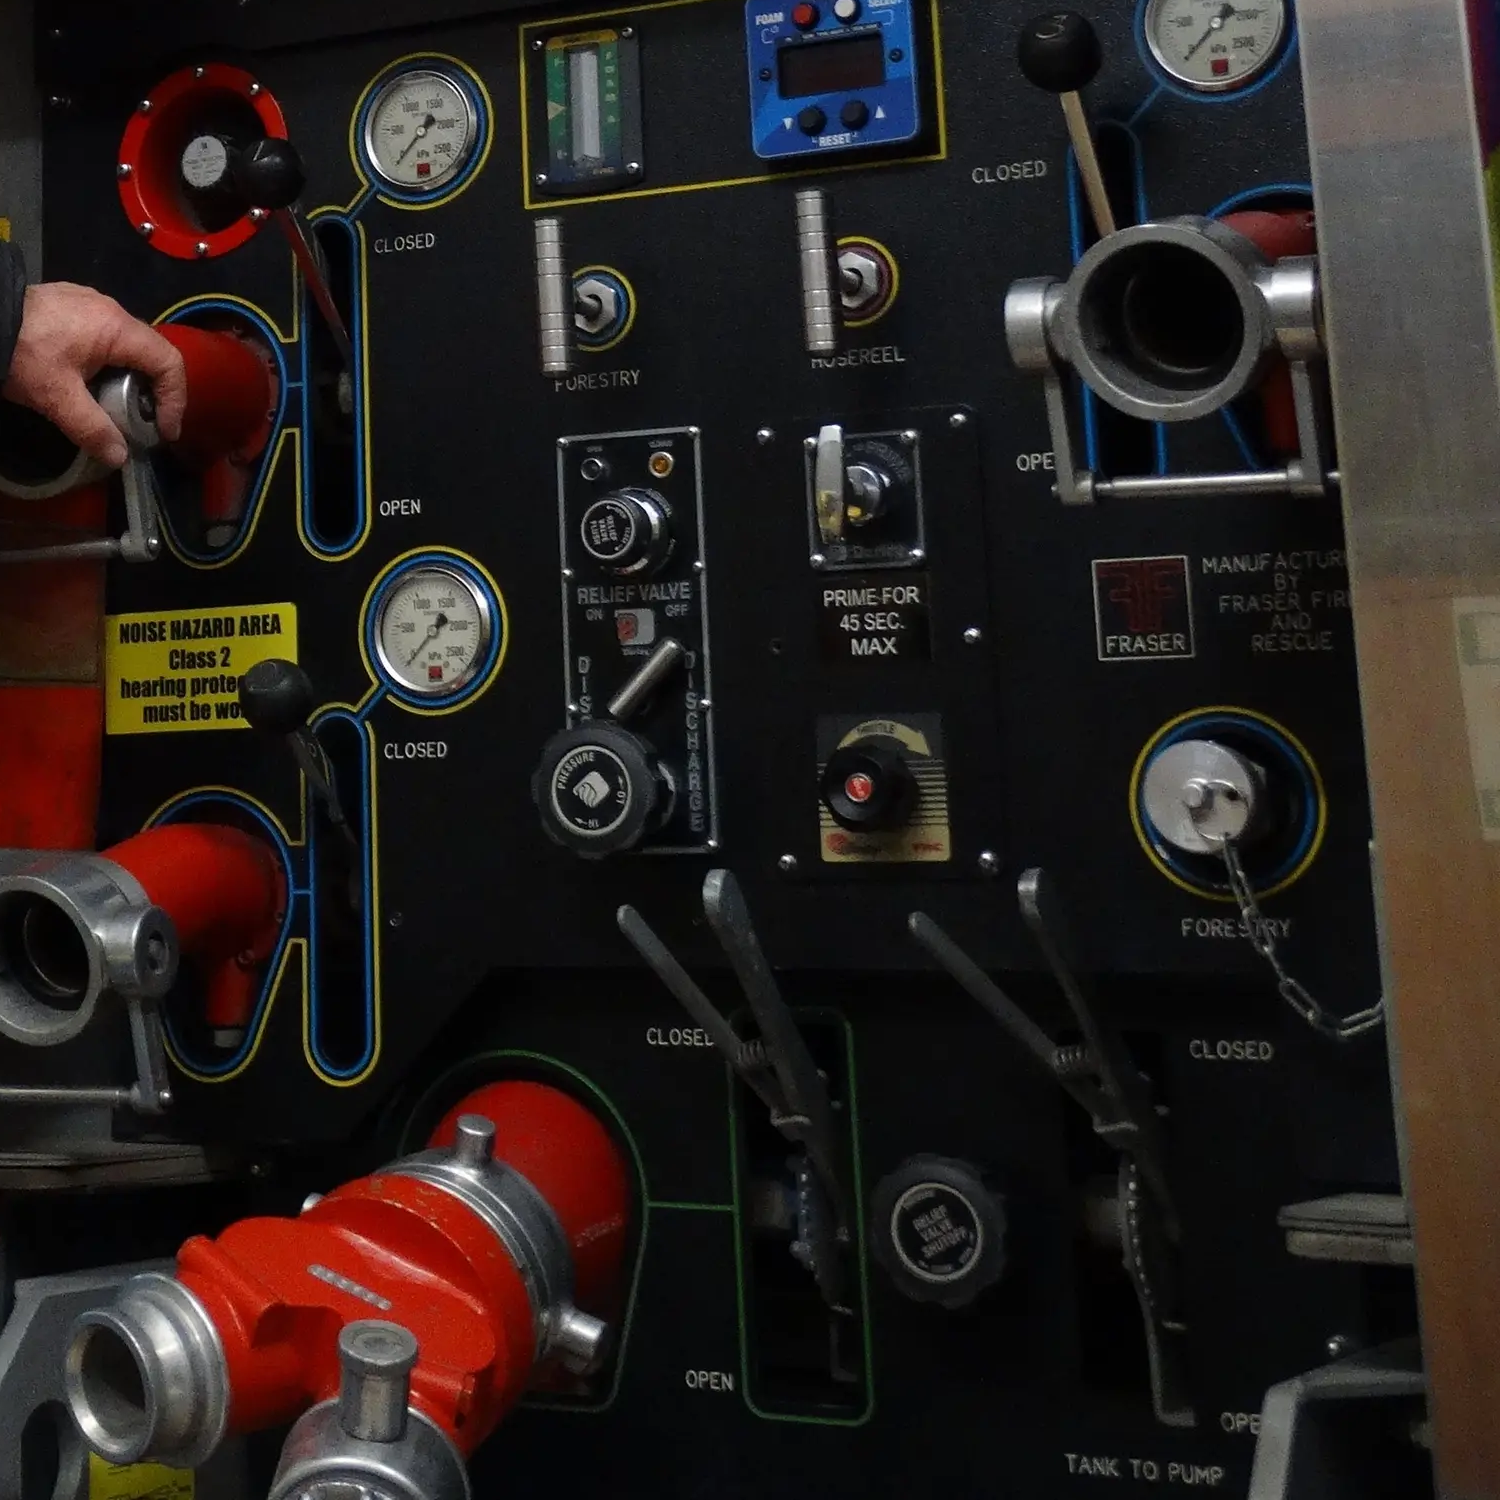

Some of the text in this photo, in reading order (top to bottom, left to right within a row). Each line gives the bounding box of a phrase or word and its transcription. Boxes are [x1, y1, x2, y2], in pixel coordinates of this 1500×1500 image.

[755, 12, 785, 26] FOAM
[818, 132, 852, 148] RESET
[971, 159, 1048, 184] CLOSED
[373, 232, 436, 254] CLOSED
[554, 369, 641, 393] FORESTRY
[1016, 452, 1055, 472] OPE
[379, 498, 421, 517] OPEN
[1201, 550, 1348, 575] MANUFACTUR
[577, 581, 693, 605] RELIEF VALVE
[1273, 574, 1300, 591] BY
[823, 585, 921, 608] PRIME FOR
[1218, 589, 1353, 615] FRASER FIR
[585, 608, 605, 622] ON
[664, 603, 690, 618] OFF
[838, 610, 908, 632] 45 SEC.
[1271, 612, 1312, 632] AND
[119, 613, 282, 644] NOISE HAZARD AREA
[850, 636, 899, 656] MAX
[1105, 633, 1186, 654] FRASER
[1252, 631, 1335, 652] RESCUE
[169, 646, 231, 670] Class 2
[121, 676, 186, 699] hearing
[143, 700, 246, 723] must be wo
[384, 740, 449, 760] CLOSED
[557, 752, 595, 790] PRESSURE
[1188, 1039, 1275, 1062] CLOSED
[912, 1204, 947, 1231] RELIEF
[919, 1217, 953, 1242] VALVE
[921, 1225, 967, 1259] SHUTOFF
[685, 1369, 735, 1392] OPEN
[1220, 1411, 1262, 1435] OPE
[1064, 1452, 1224, 1486] TANK TO PUMP
